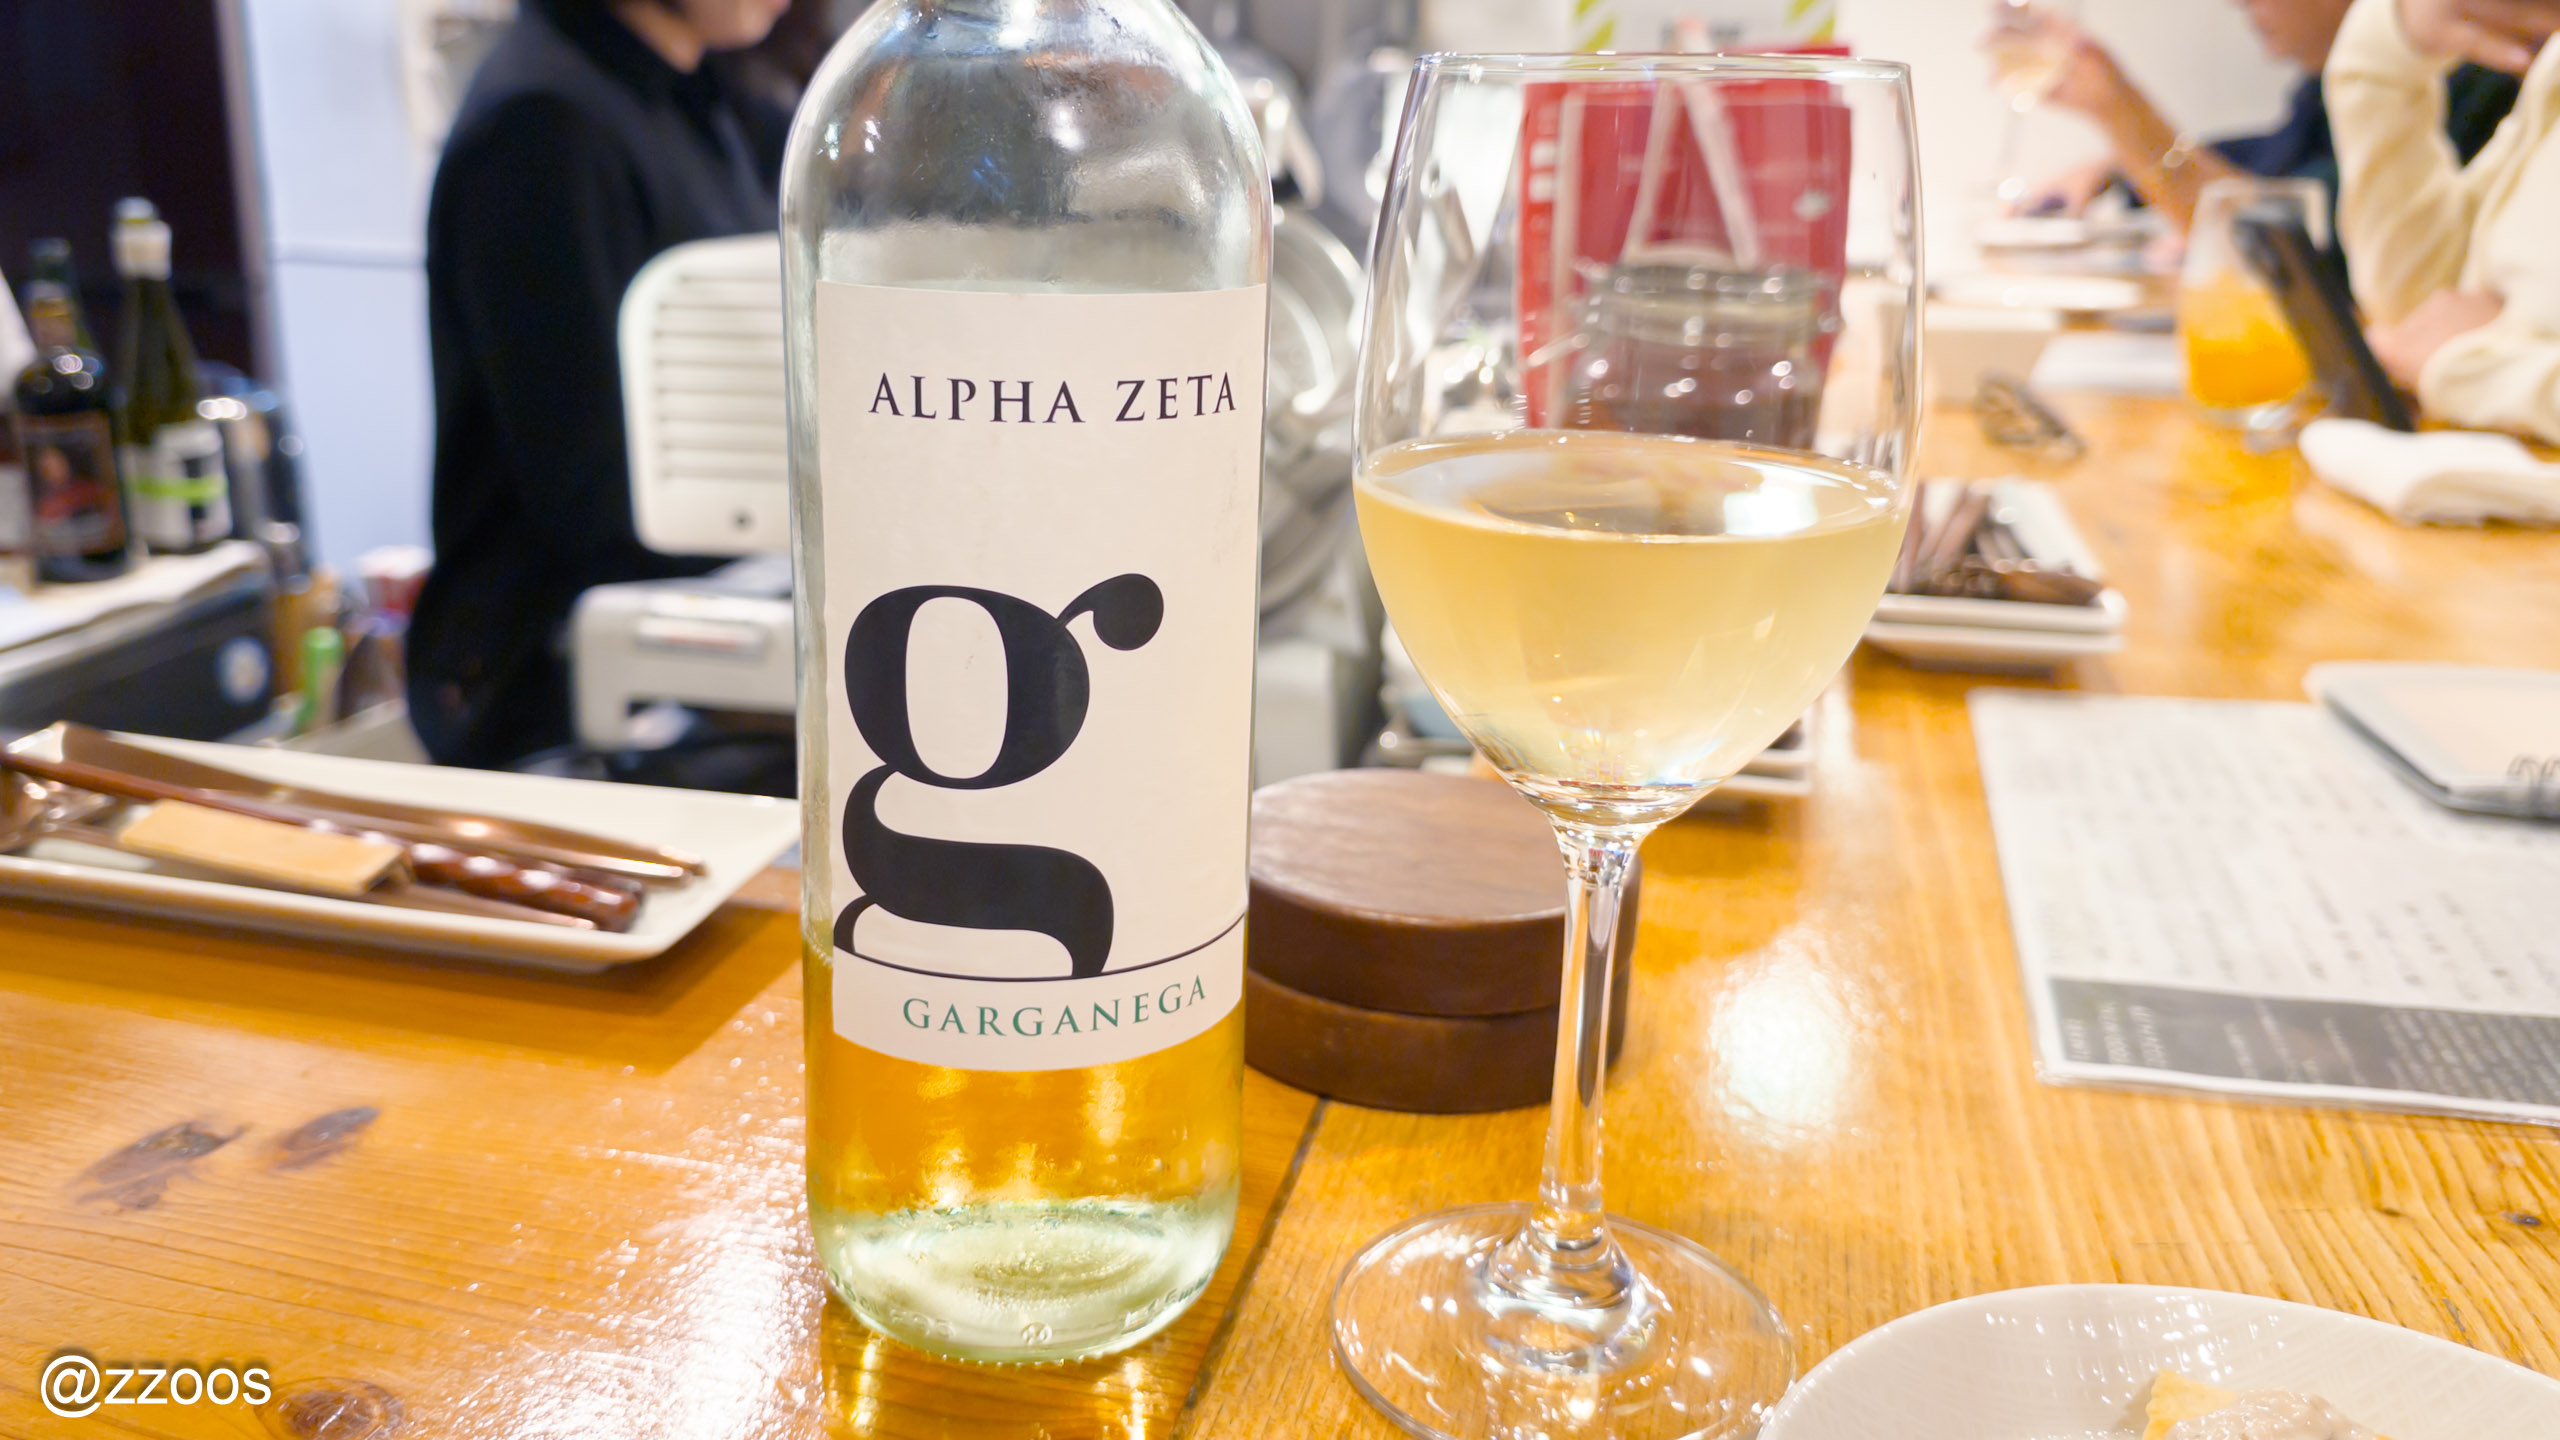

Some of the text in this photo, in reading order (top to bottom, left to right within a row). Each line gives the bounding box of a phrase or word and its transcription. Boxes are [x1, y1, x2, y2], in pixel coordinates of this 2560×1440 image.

[868, 371, 1238, 424] ALPHA ZETA
[833, 572, 1165, 979] g
[902, 974, 1206, 1038] GARGANEGA
